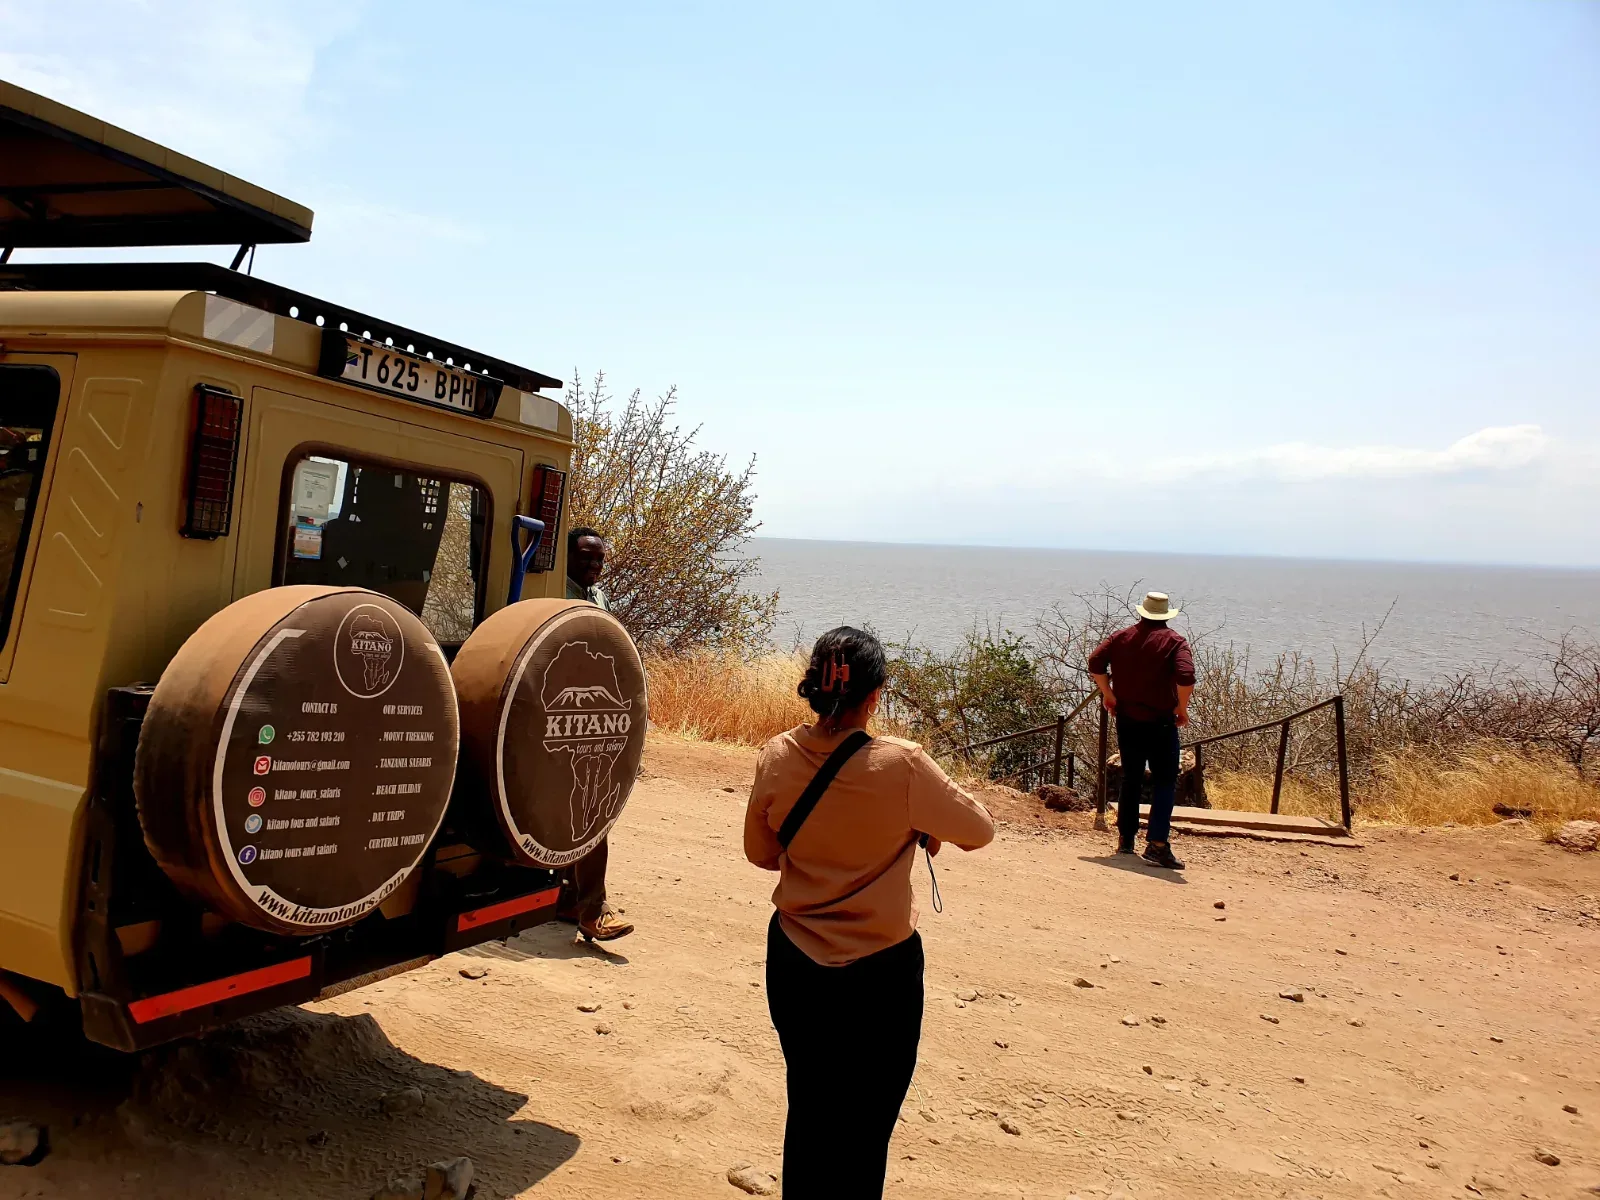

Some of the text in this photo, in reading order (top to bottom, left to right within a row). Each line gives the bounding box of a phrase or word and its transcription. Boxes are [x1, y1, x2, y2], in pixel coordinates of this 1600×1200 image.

[360, 347, 475, 408] T 625 BPH
[351, 640, 392, 653] KITANO
[301, 701, 338, 714] CONTACT US
[382, 704, 423, 716] OUR SERVICES
[545, 713, 631, 737] KITANO
[286, 731, 345, 742] +255 782 193 210
[383, 731, 434, 742] MOUNT TREKKING
[272, 759, 351, 772] kitanotours@gmail.com
[380, 757, 432, 768] TANZANIA SAFARIS
[375, 784, 397, 796] BEACH
[266, 819, 290, 830] kitano
[305, 816, 319, 828] and
[319, 814, 340, 827] safaris
[372, 810, 405, 822] DAY TRIPS
[259, 842, 338, 860] kitano tours and safaris
[257, 872, 405, 924] www.kitanotours.com
